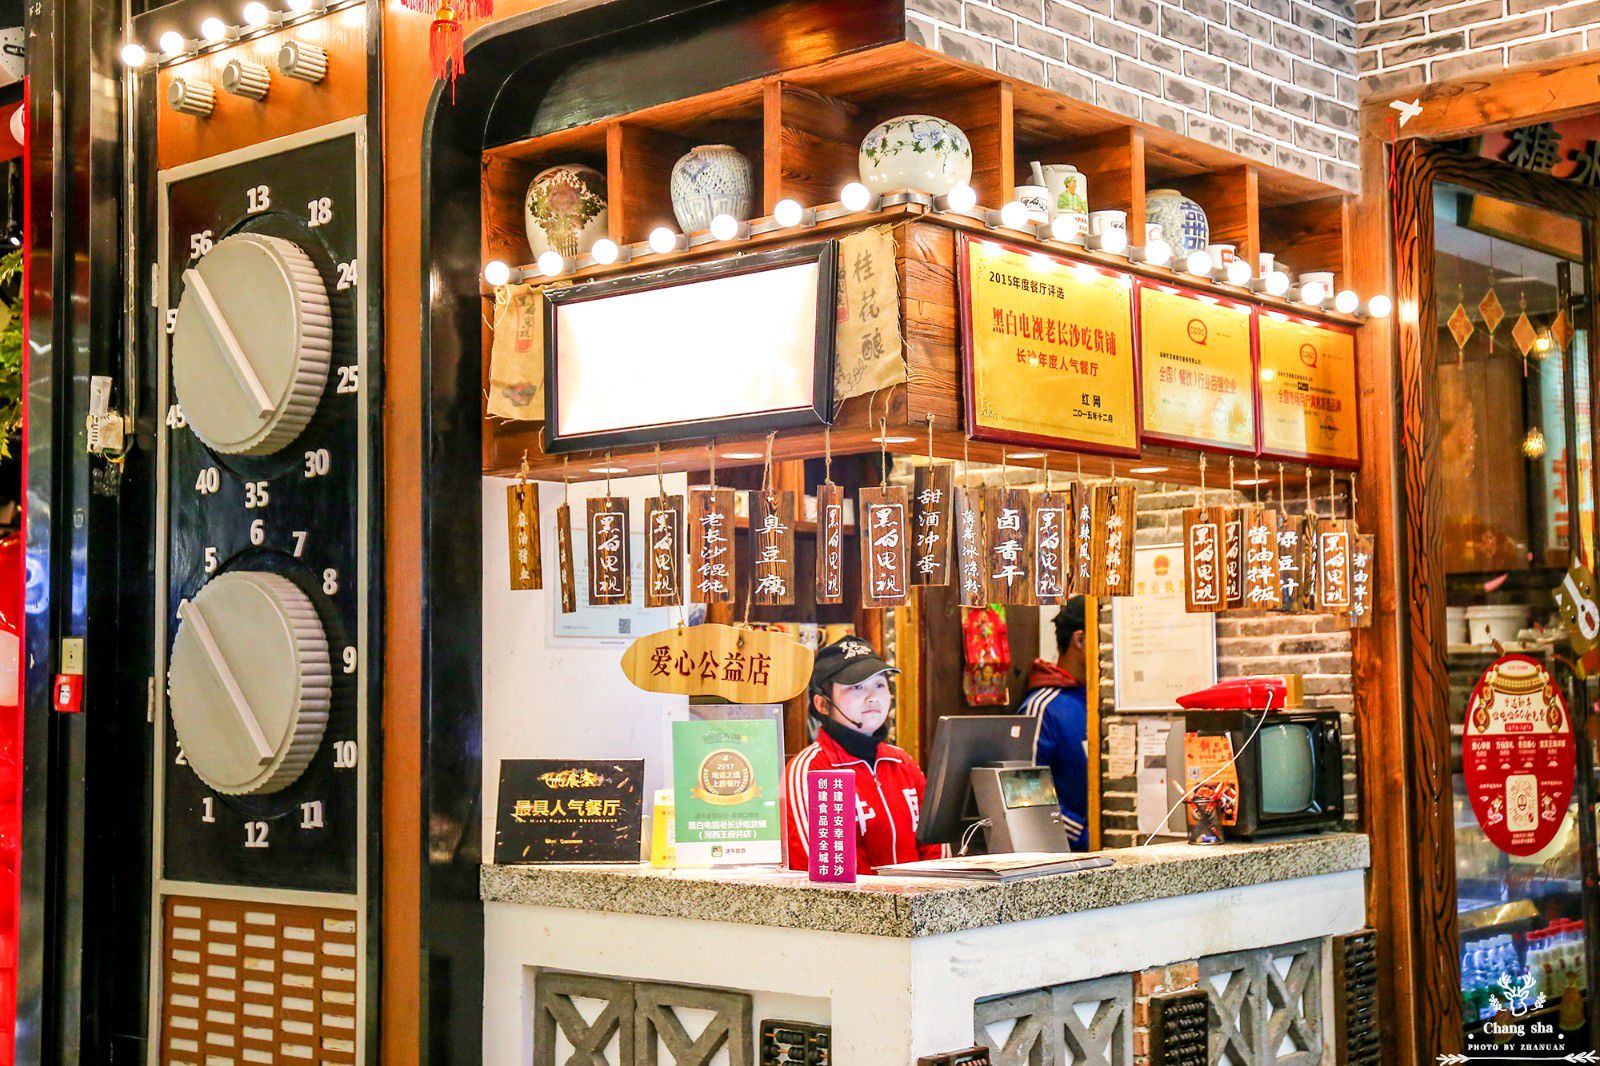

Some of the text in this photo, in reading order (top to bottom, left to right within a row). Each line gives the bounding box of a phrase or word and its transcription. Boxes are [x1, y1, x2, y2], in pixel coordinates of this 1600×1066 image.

[246, 184, 270, 214] 13
[307, 197, 333, 227] 18
[190, 229, 213, 260] 56
[336, 259, 358, 290] 24
[989, 271, 1065, 300] 2015年度餐厅评选
[852, 249, 885, 360] 桂花酿
[992, 306, 1117, 357] 黑白电视老长沙吃货铺
[336, 365, 358, 393] 25
[165, 404, 187, 429] 45
[304, 448, 331, 478] 30
[195, 467, 220, 494] 40
[244, 481, 269, 509] 35
[250, 519, 265, 546] 6
[292, 531, 308, 557] 7
[916, 488, 943, 575] 甜酒冲蛋
[204, 546, 218, 573] 5
[597, 516, 621, 592] 黑白电视
[653, 513, 674, 592] 黑白电视
[697, 512, 730, 593] 老长沙馄饨
[755, 514, 789, 596] 臭豆腐
[828, 508, 840, 592] 黑白电视
[873, 508, 902, 592] 黑白电视
[1039, 511, 1061, 593] 黑白电视
[1194, 527, 1217, 600] 黑白电视
[322, 568, 338, 595] 8
[1324, 535, 1347, 602] 黑白电视
[342, 646, 357, 674] 9
[650, 644, 772, 686] 爱心公益店
[333, 740, 358, 768] 10
[202, 797, 216, 823] 1
[300, 800, 324, 829] 11
[514, 799, 621, 818] 最具人气餐厅
[244, 821, 269, 848] 12
[818, 778, 829, 876] 创建食品安全城市
[833, 778, 844, 876] 共建平安幸福长沙
